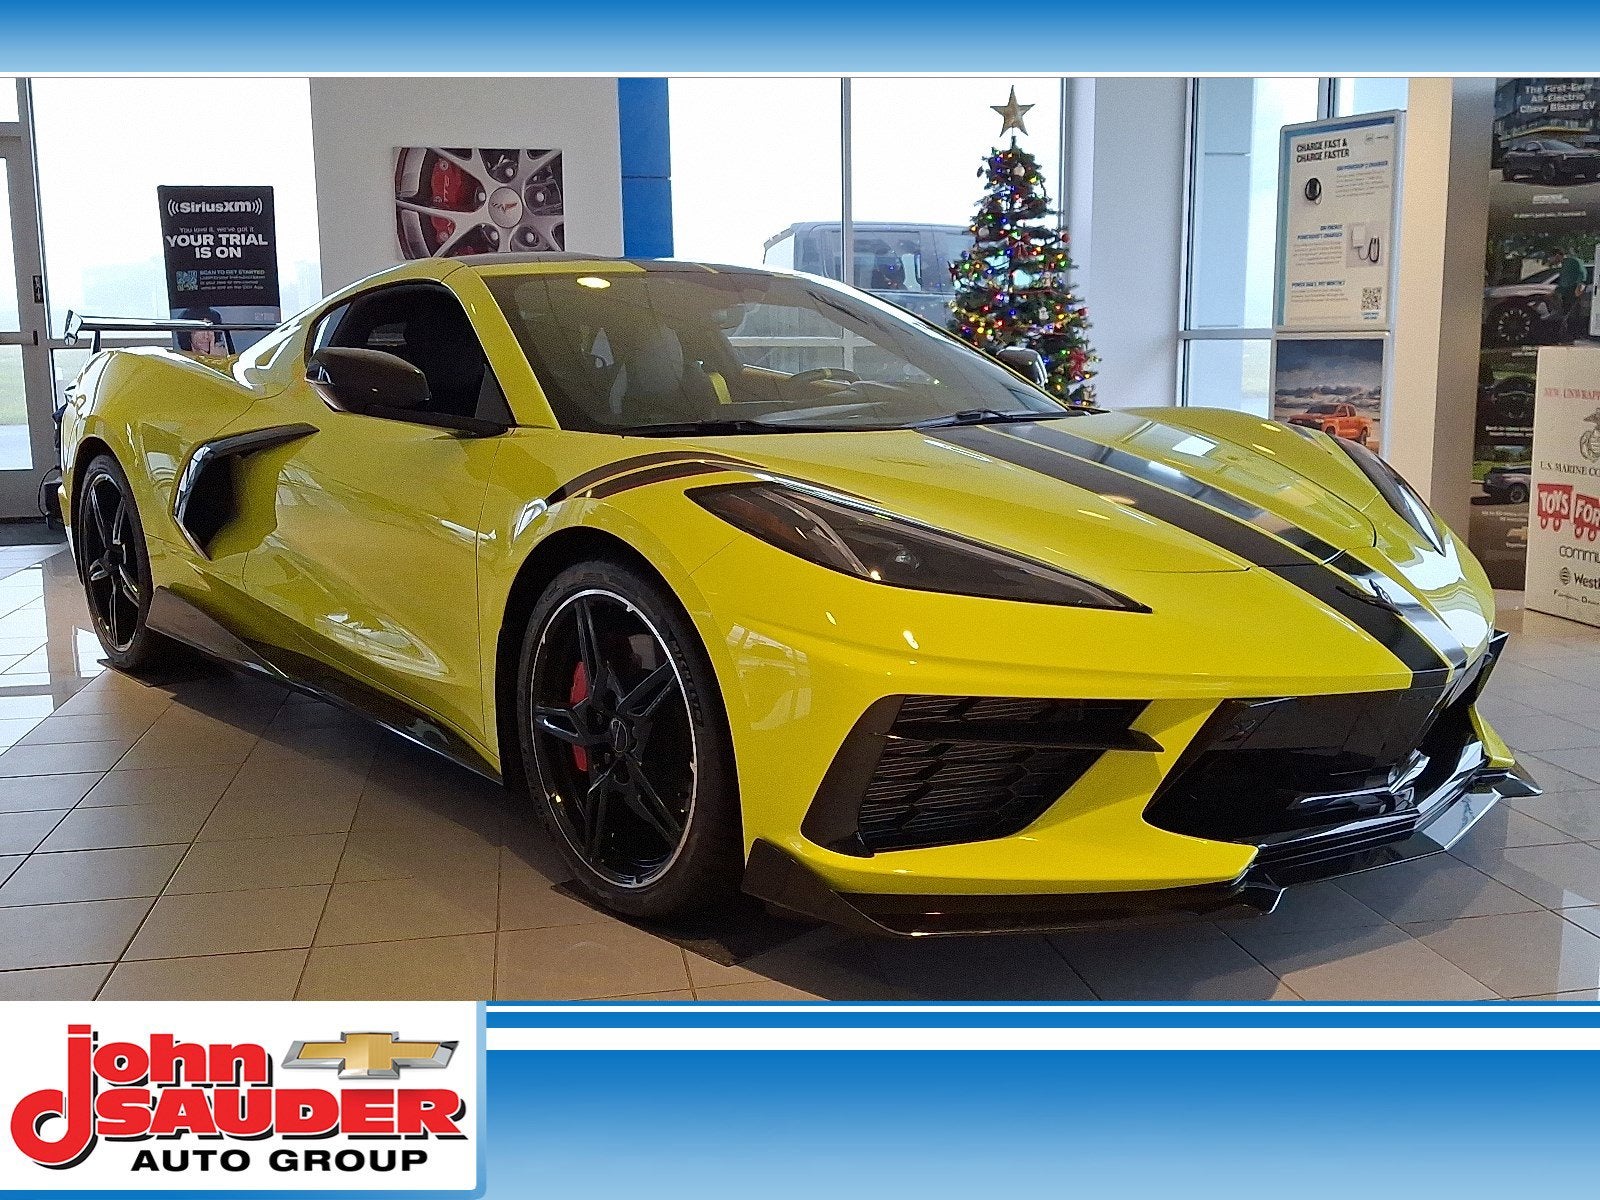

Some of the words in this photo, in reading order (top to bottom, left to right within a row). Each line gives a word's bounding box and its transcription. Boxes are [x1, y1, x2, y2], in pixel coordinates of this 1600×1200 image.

[1525, 85, 1542, 94] The
[1544, 82, 1593, 93] First-Ever
[1530, 92, 1586, 104] All-Electric
[1519, 104, 1549, 114] Chevy
[1549, 102, 1581, 112] Blazer
[1582, 100, 1596, 110] EV
[1296, 140, 1323, 153] CHARGE
[1323, 138, 1341, 149] FAST
[1296, 151, 1323, 163] CHARGE
[1324, 148, 1350, 160] FASTER
[165, 233, 214, 247] YOUR
[218, 233, 268, 246] TRIAL
[195, 247, 212, 259] IS
[215, 246, 242, 259] ON
[1555, 462, 1587, 475] MARINE
[1539, 489, 1569, 516] TOYS
[1575, 499, 1600, 528] FOR
